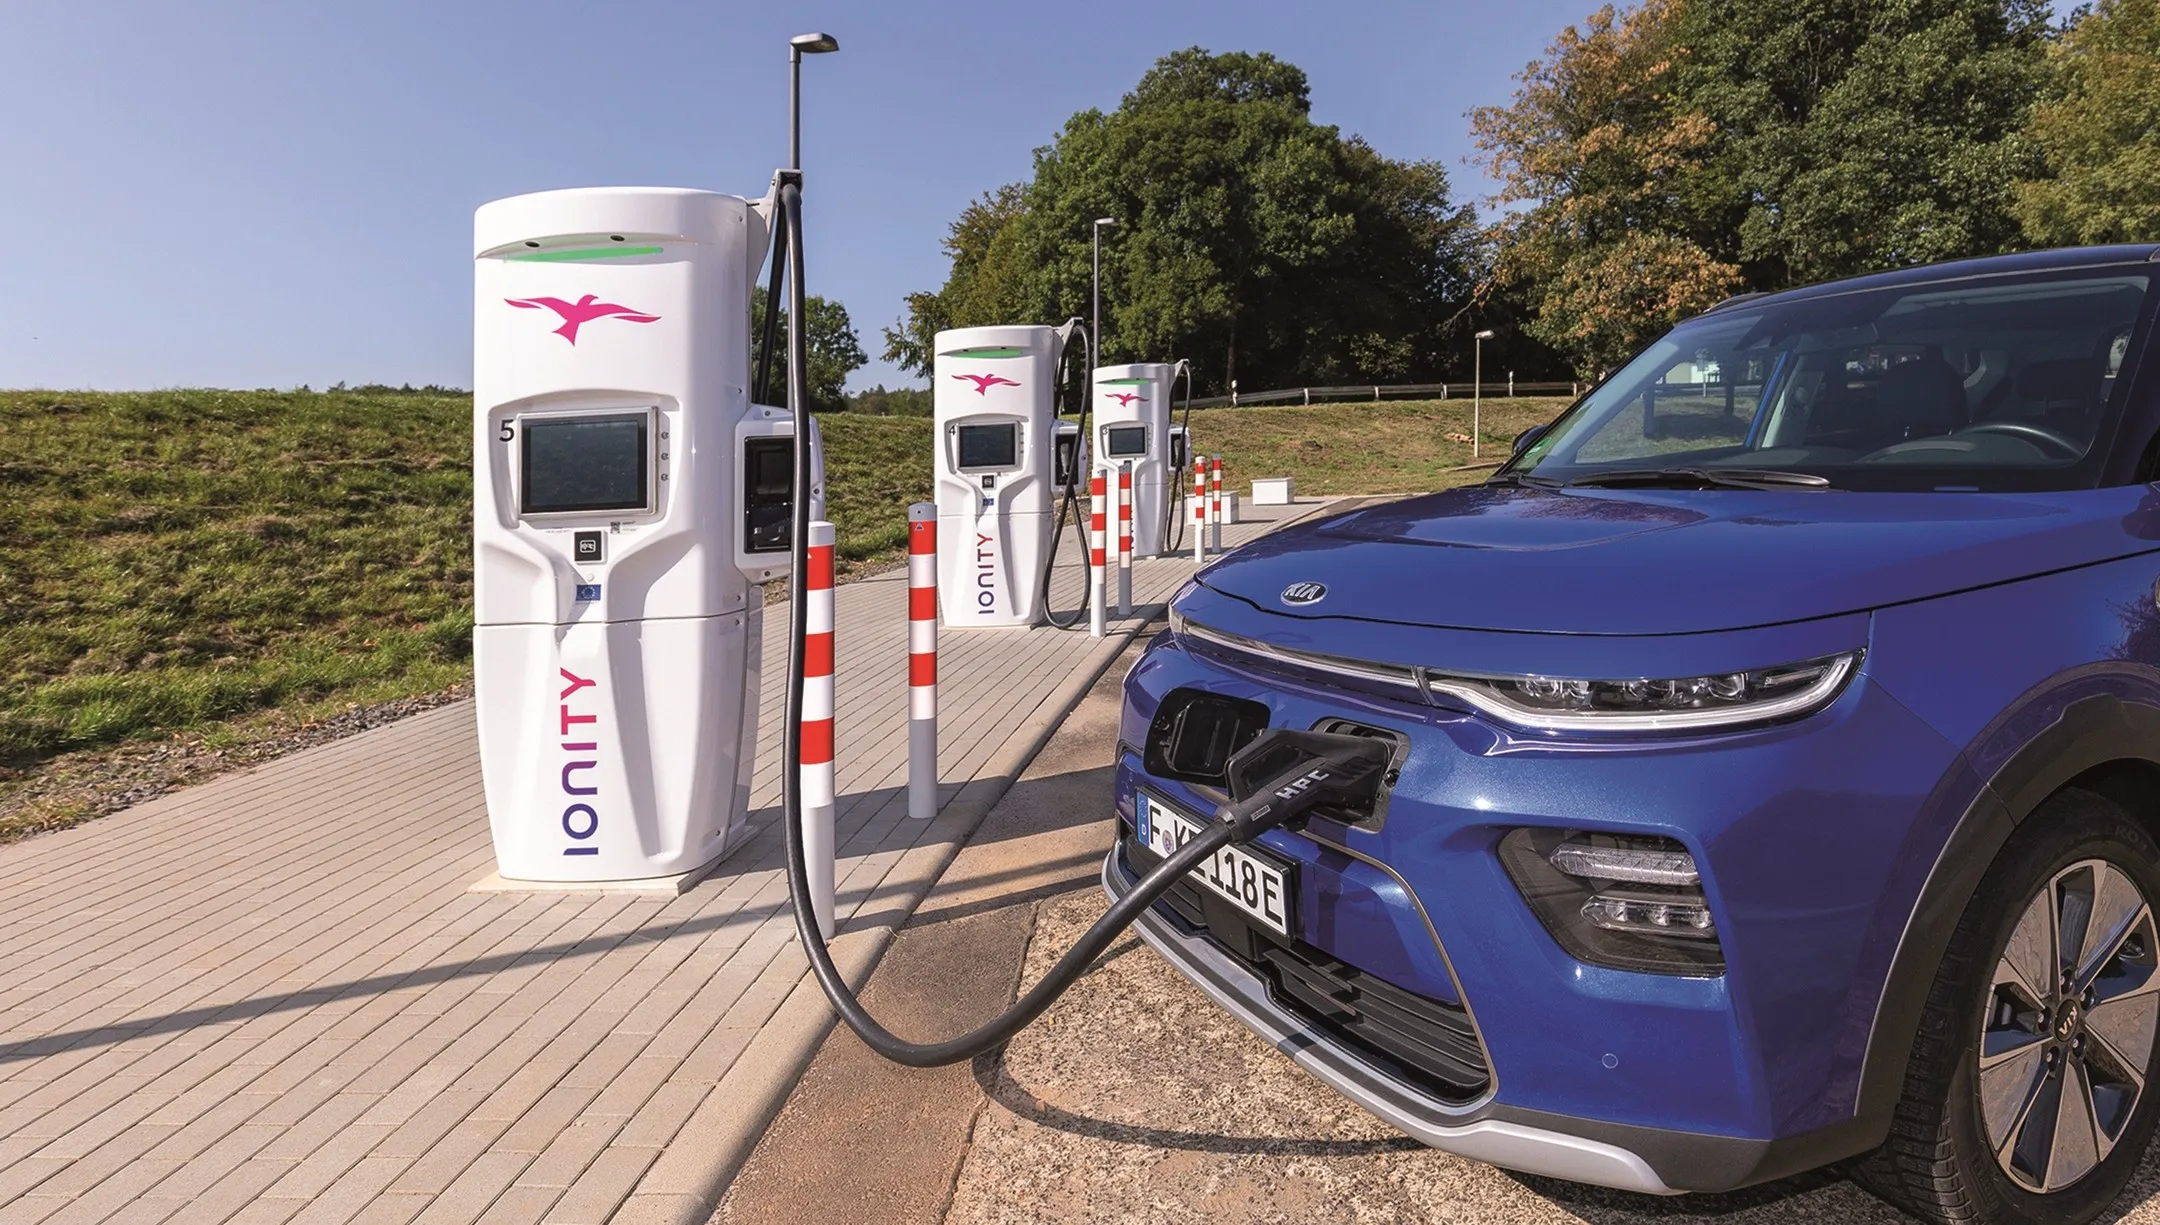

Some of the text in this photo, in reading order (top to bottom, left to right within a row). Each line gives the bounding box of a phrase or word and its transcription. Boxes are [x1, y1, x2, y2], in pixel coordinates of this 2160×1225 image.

[498, 419, 515, 442] 5
[947, 427, 956, 436] 4
[977, 533, 994, 614] IONITY
[1284, 582, 1320, 600] KIA
[560, 667, 599, 856] IONITY
[1276, 770, 1330, 801] HPC
[1149, 804, 1161, 844] F
[2058, 1005, 2078, 1035] KIA
